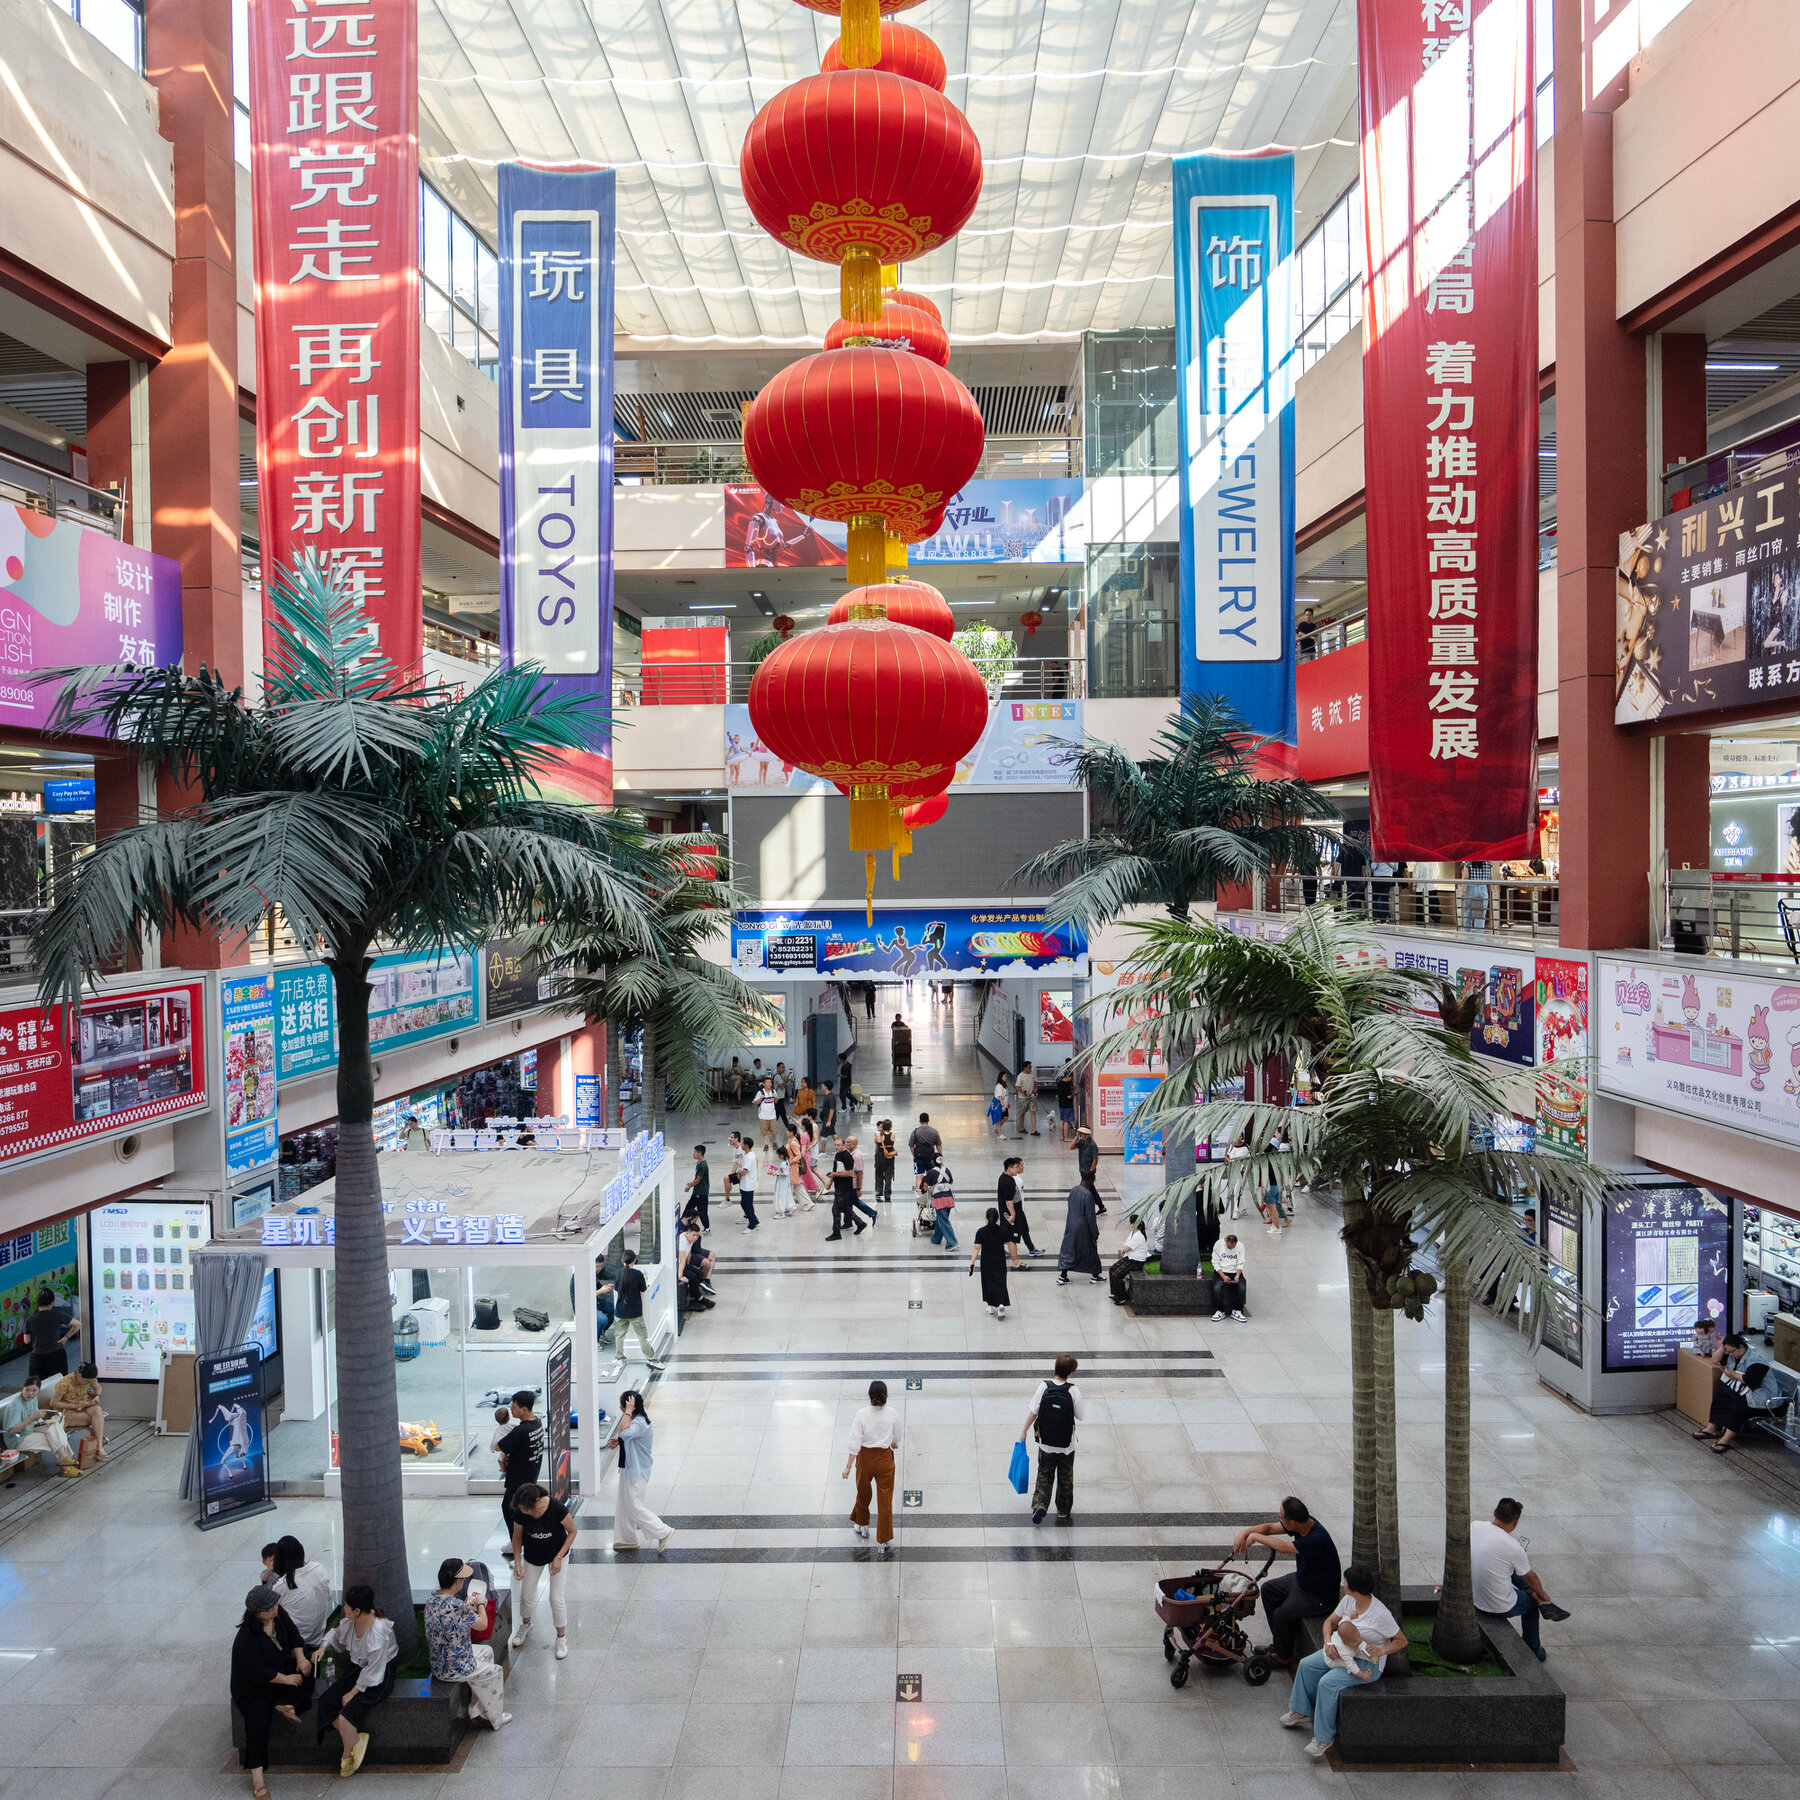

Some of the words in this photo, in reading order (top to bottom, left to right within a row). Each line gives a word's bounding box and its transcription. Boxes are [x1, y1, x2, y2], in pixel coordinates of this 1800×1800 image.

[285, 0, 379, 285] 远跟党走
[528, 250, 585, 403] 玩具
[289, 322, 386, 683] 再创新辉
[1681, 478, 1800, 559] 利兴工
[537, 474, 577, 627] TOYS
[1425, 341, 1480, 760] 着力推动高质量发展
[1680, 533, 1800, 585] 主要销售：雨丝门帘，
[116, 557, 153, 594] 设计
[103, 592, 142, 628] 制作
[119, 633, 156, 667] 发布
[1014, 705, 1074, 718] INTEX
[1311, 693, 1362, 733] 我诚信
[280, 973, 328, 1003] 开店免费
[1616, 980, 1651, 1011] 贝丝兔
[17, 1020, 37, 1037] 乐享
[280, 998, 329, 1037] 送货柜
[18, 1035, 38, 1052] 奇思
[0, 1081, 37, 1098] 潮玩集合店
[16, 1109, 28, 1121] 877
[405, 1200, 448, 1214] star
[1685, 1219, 1704, 1228] PARTY
[400, 1215, 526, 1246] 义乌智造
